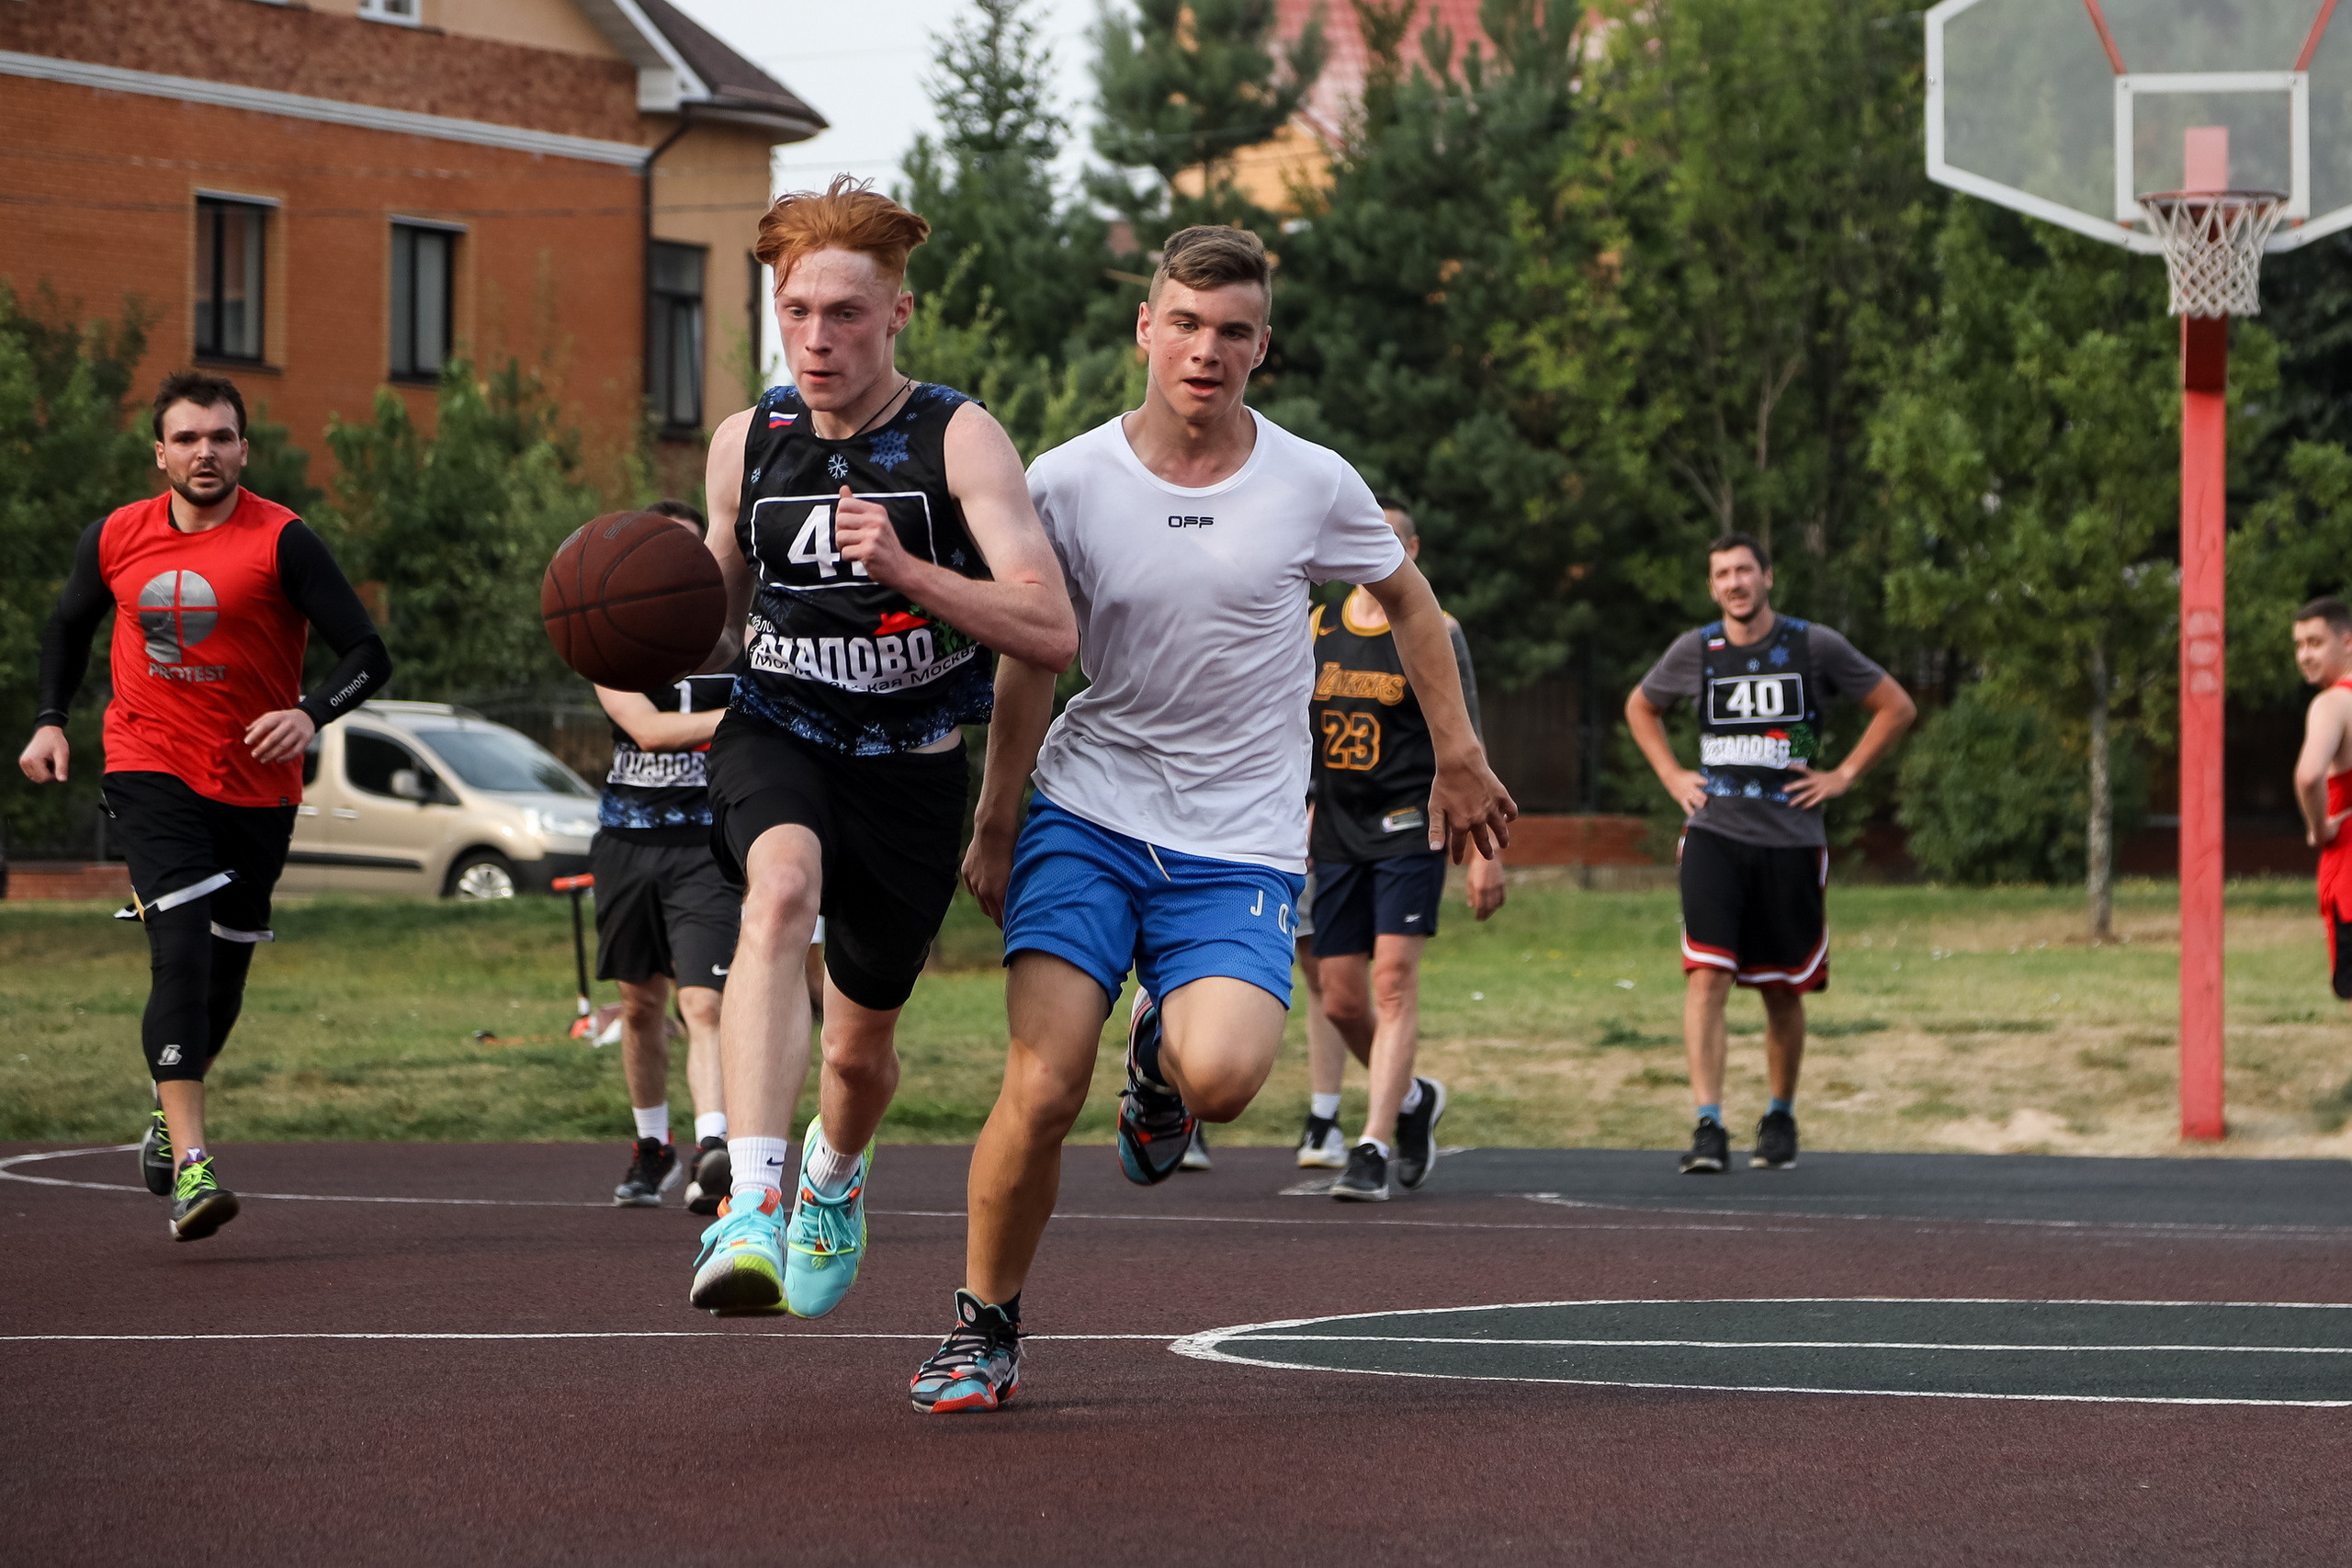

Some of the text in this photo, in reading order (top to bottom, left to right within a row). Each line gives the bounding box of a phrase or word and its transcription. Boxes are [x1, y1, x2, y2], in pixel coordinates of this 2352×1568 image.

[787, 504, 868, 579] 4
[148, 662, 227, 683] PROTEST
[329, 670, 370, 708] OUTSHOCK
[1725, 679, 1784, 718] 40
[1321, 709, 1381, 771] 23
